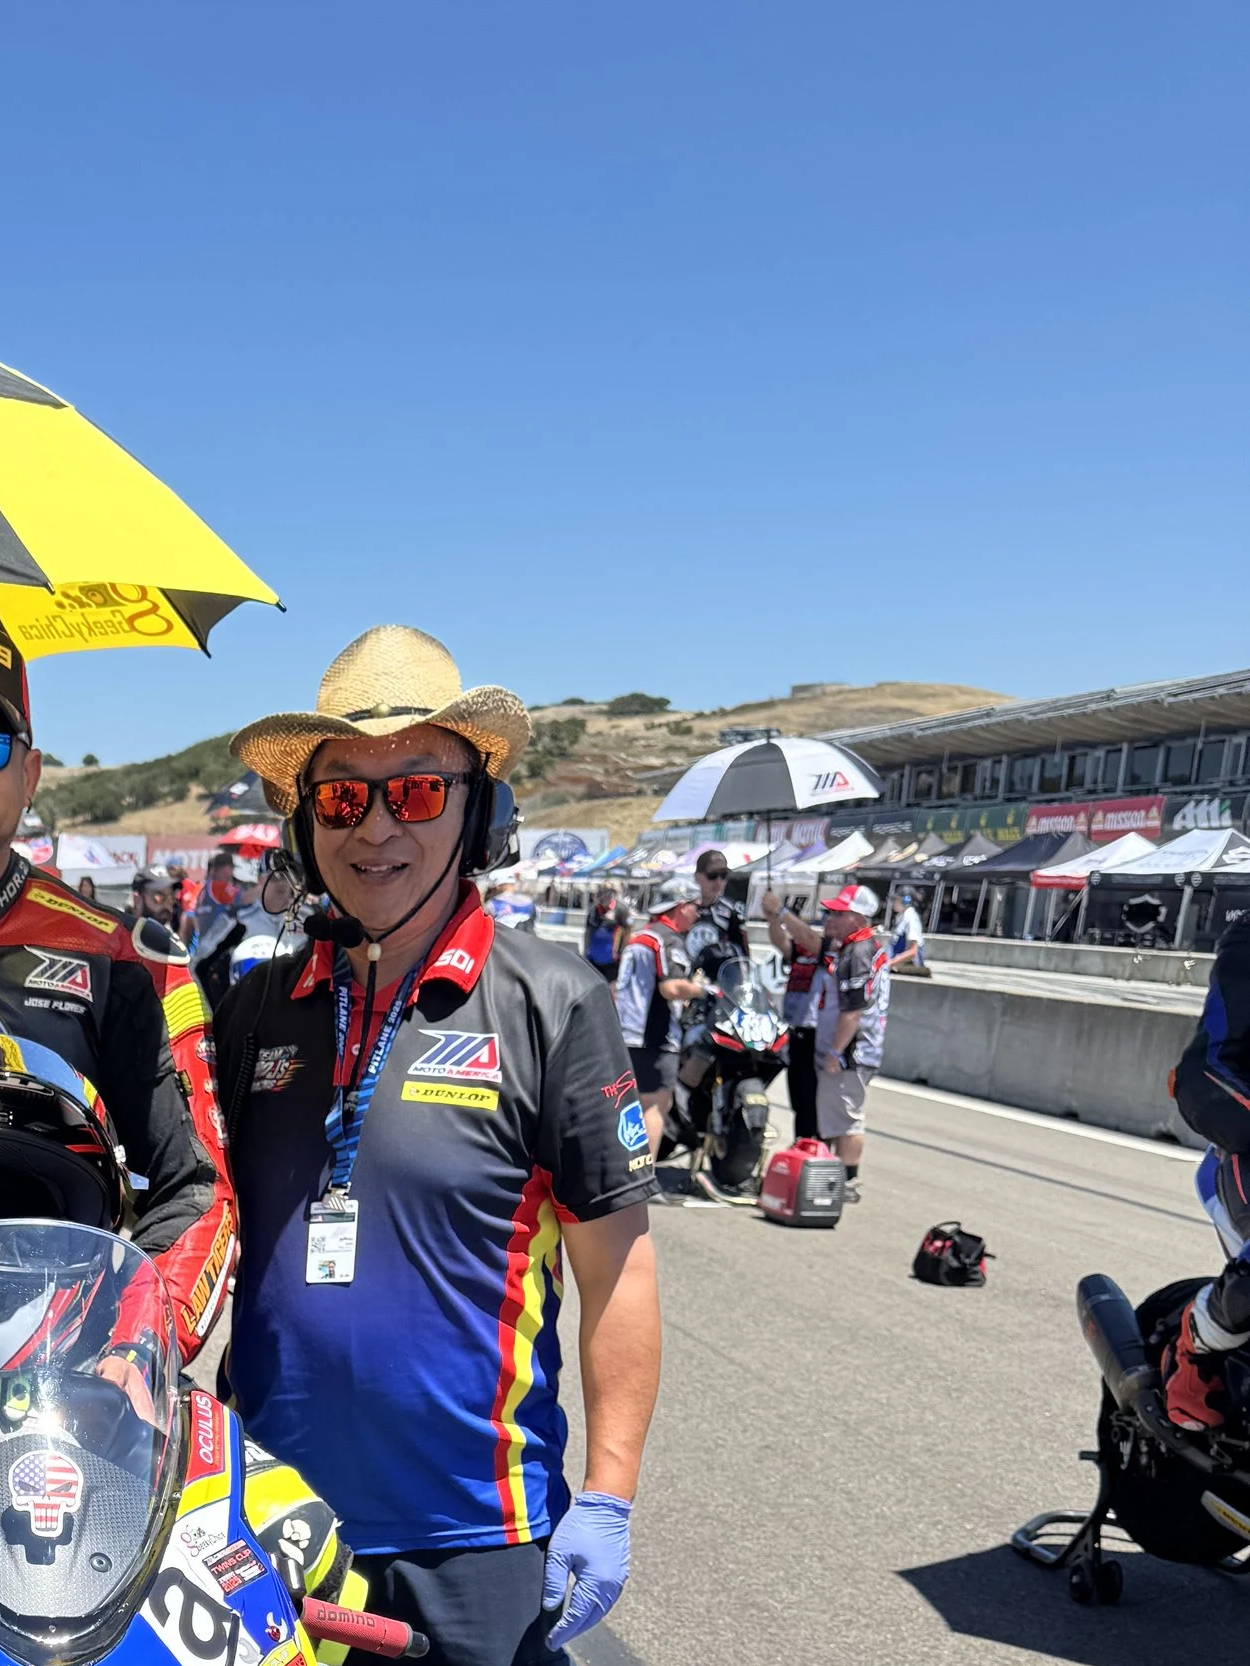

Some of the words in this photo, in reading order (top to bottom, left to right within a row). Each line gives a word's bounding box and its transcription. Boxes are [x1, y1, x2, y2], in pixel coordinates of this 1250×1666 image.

[43, 897, 110, 928] DUNLOP
[24, 996, 51, 1009] JOSE
[51, 998, 87, 1015] FLORES
[338, 985, 348, 1033] PITLANE
[367, 1025, 393, 1075] PITLANE
[412, 1065, 500, 1081] MOTOAMERICA
[421, 1089, 492, 1102] DUNLOP
[179, 1271, 211, 1337] LAW
[195, 1395, 214, 1465] OCULUS
[212, 1557, 237, 1575] TWINS
[235, 1548, 252, 1564] CUP
[316, 1603, 376, 1628] domino
